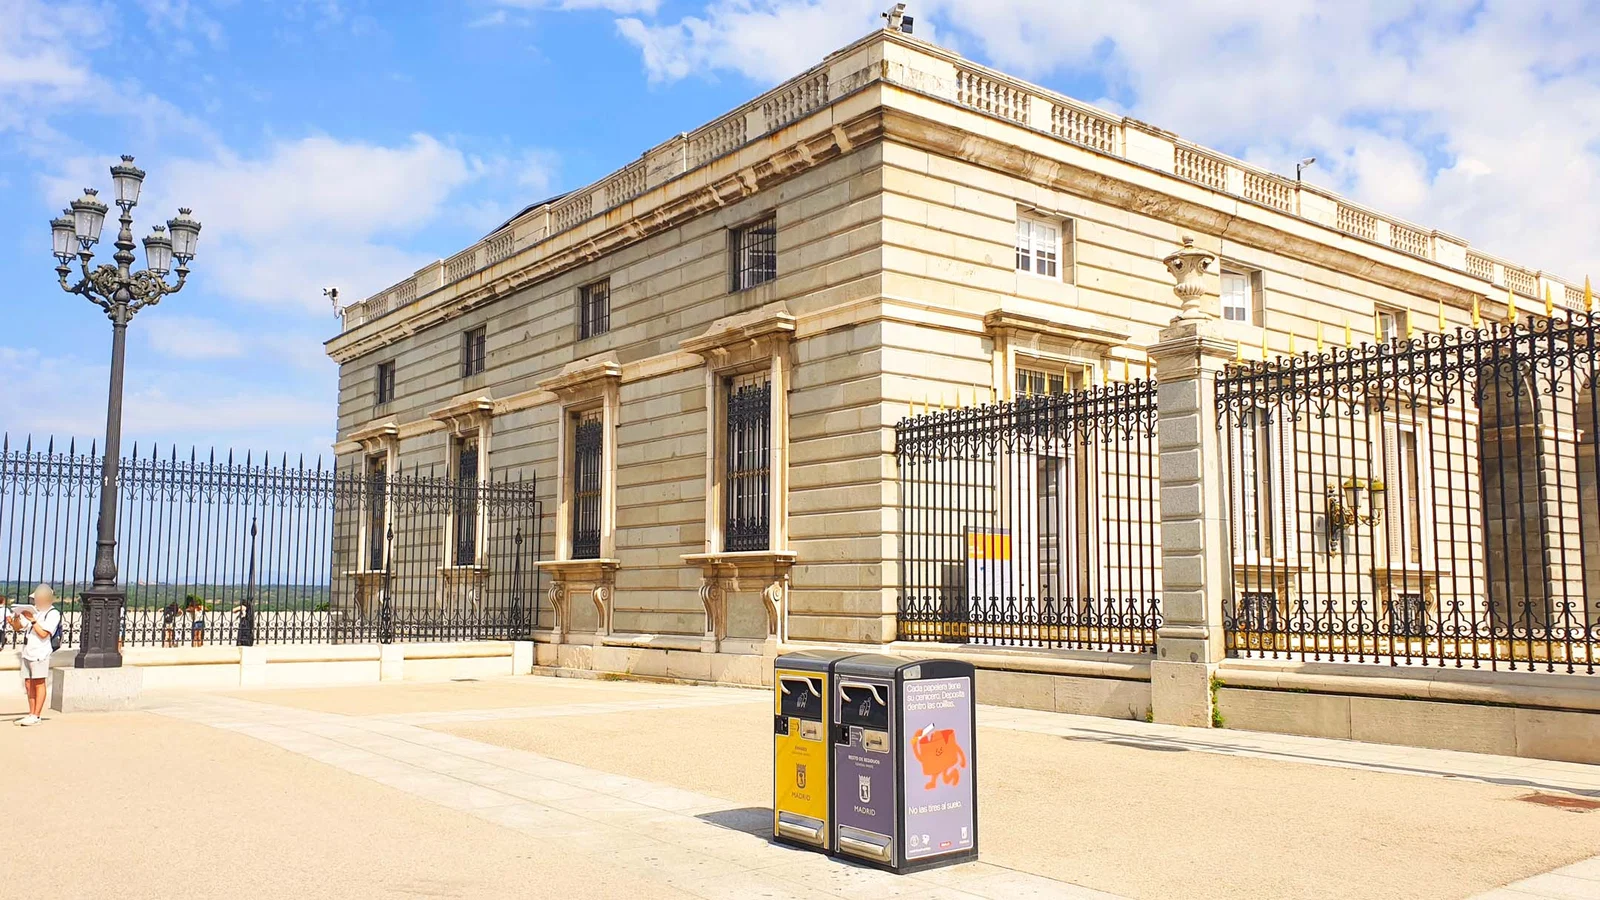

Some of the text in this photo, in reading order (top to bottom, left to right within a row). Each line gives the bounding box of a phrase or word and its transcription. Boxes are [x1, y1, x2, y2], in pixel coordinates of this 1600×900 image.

[907, 682, 961, 692] Cada papelera tiene
[907, 702, 926, 711] dentro
[927, 701, 935, 709] las
[792, 792, 811, 801] MADRID
[854, 806, 876, 816] MADRID
[908, 806, 917, 815] No
[919, 805, 928, 814] las
[928, 804, 940, 812] tires
[941, 802, 946, 810] al
